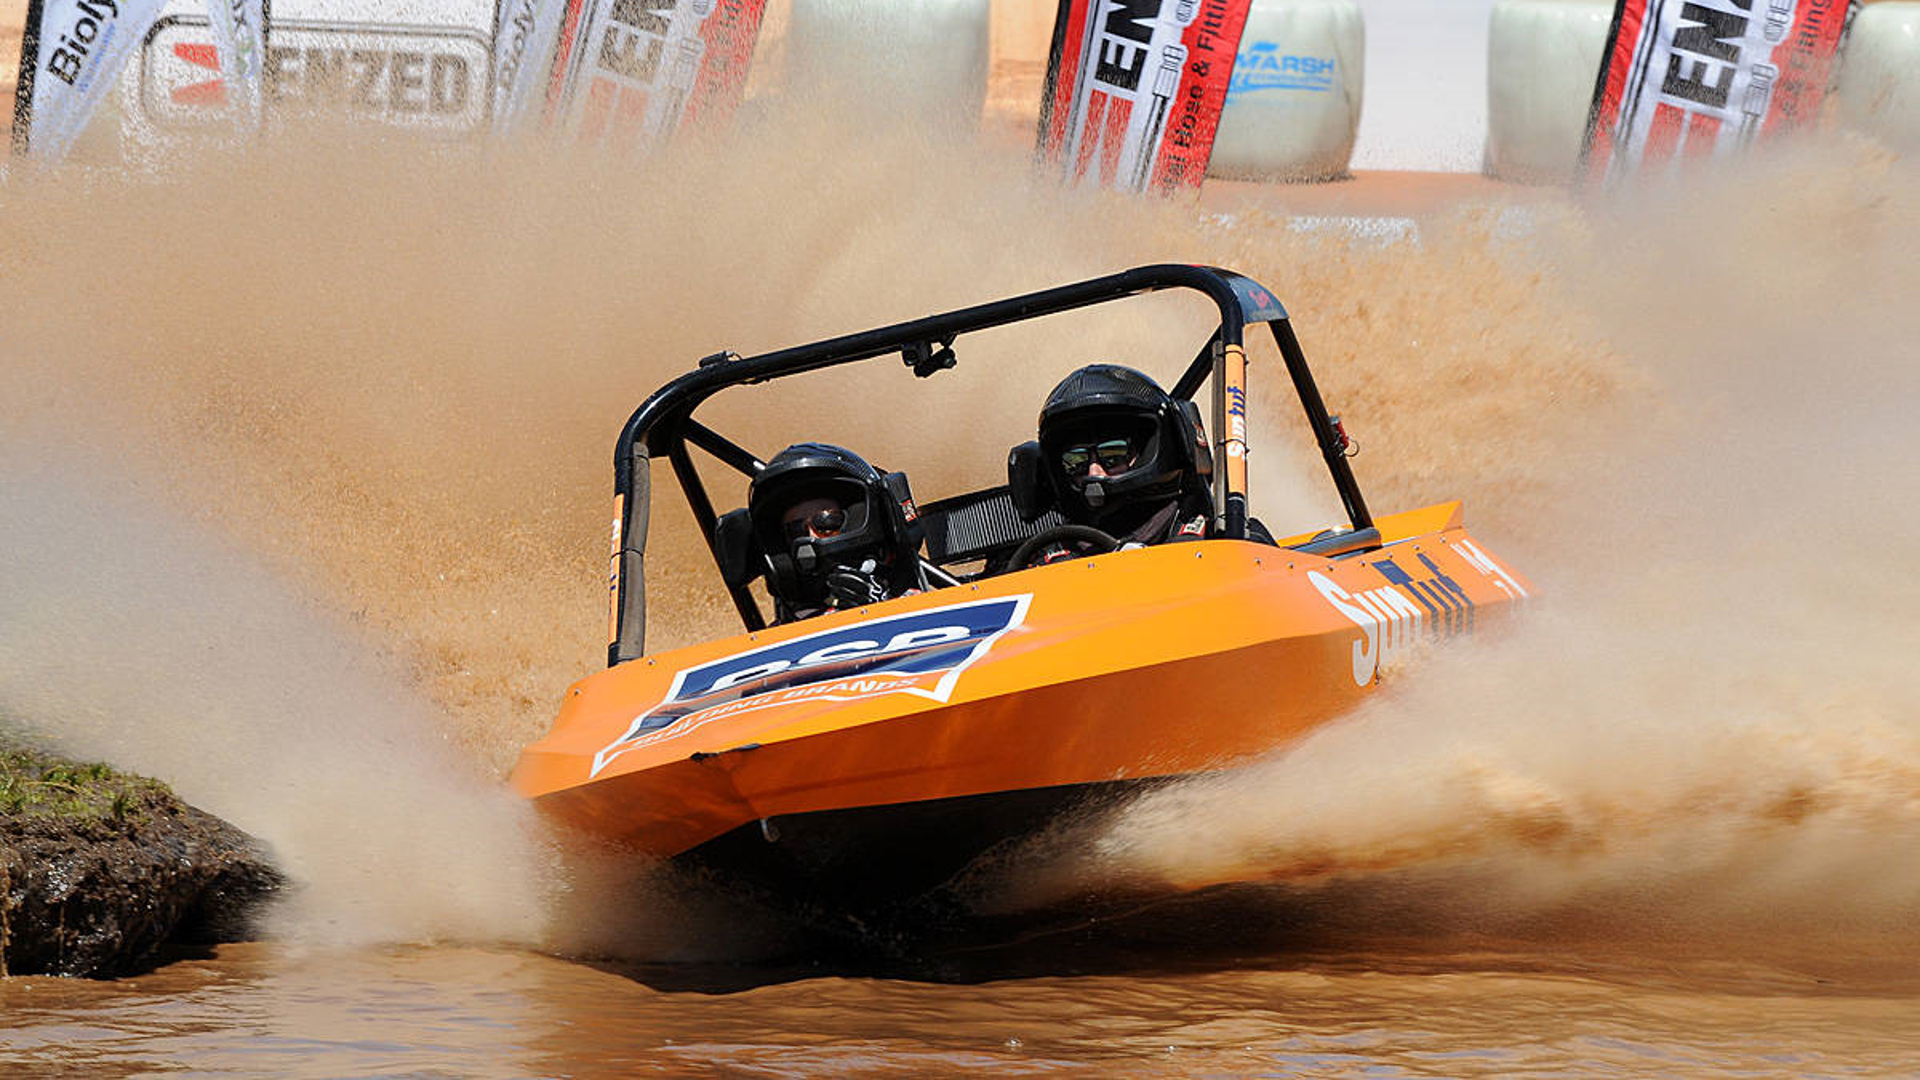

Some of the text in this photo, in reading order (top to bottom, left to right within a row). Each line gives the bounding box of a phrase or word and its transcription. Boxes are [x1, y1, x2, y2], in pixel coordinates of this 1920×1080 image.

[1197, 0, 1228, 51] Fitti
[1191, 60, 1211, 78] &
[1173, 85, 1205, 149] Hose
[782, 676, 921, 700] BRANDS
